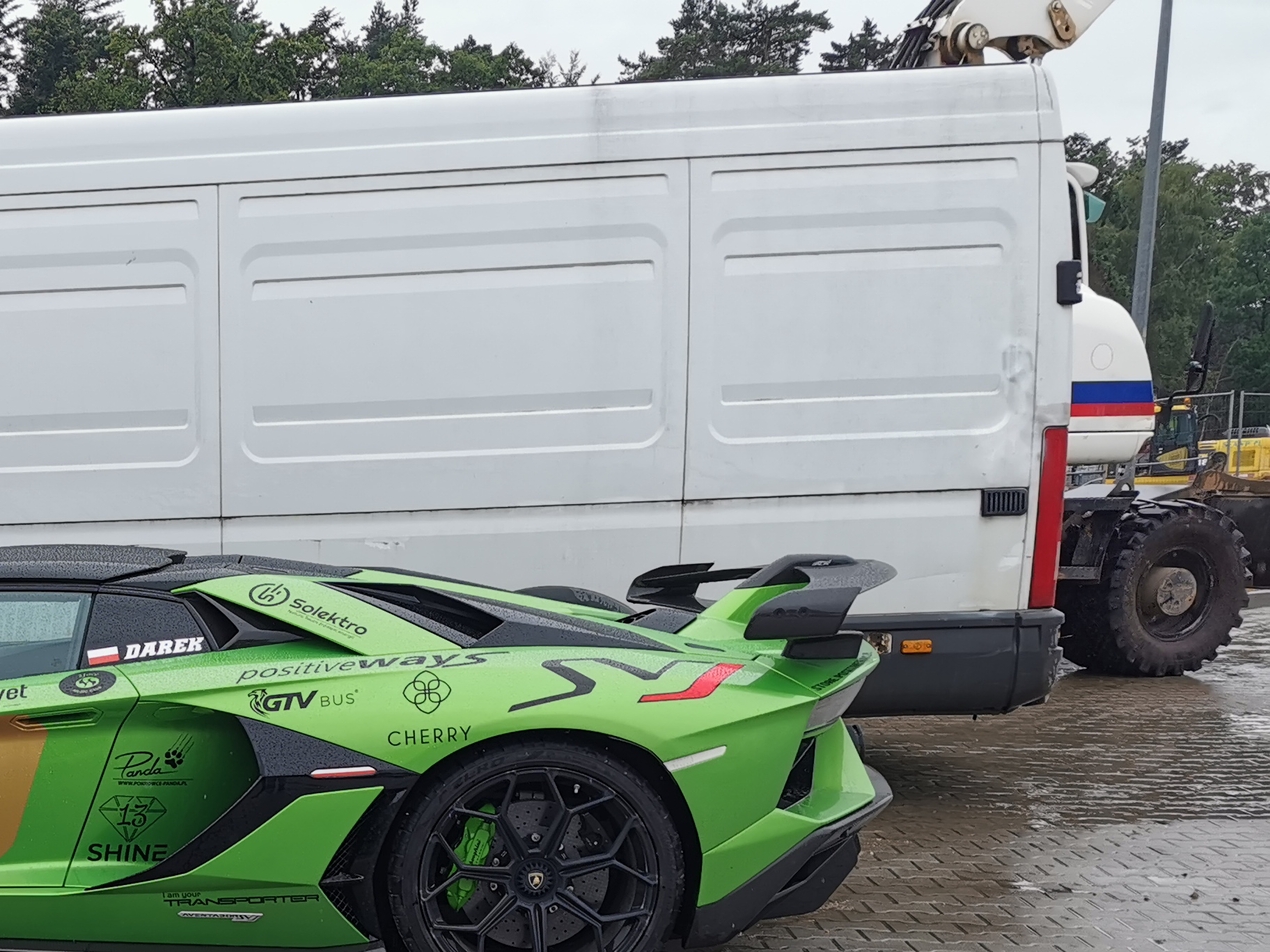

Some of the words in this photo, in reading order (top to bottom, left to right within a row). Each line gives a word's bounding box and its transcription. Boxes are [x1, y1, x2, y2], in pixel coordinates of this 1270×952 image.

[289, 598, 367, 635] Solektro
[123, 636, 205, 660] DAREK
[235, 651, 510, 685] positiveways
[262, 690, 318, 712] GTV
[387, 725, 472, 747] CHERRY
[113, 751, 179, 779] Panda
[116, 803, 149, 828] 13
[86, 843, 169, 862] SHINE
[164, 894, 320, 907] TRANSPORTER
